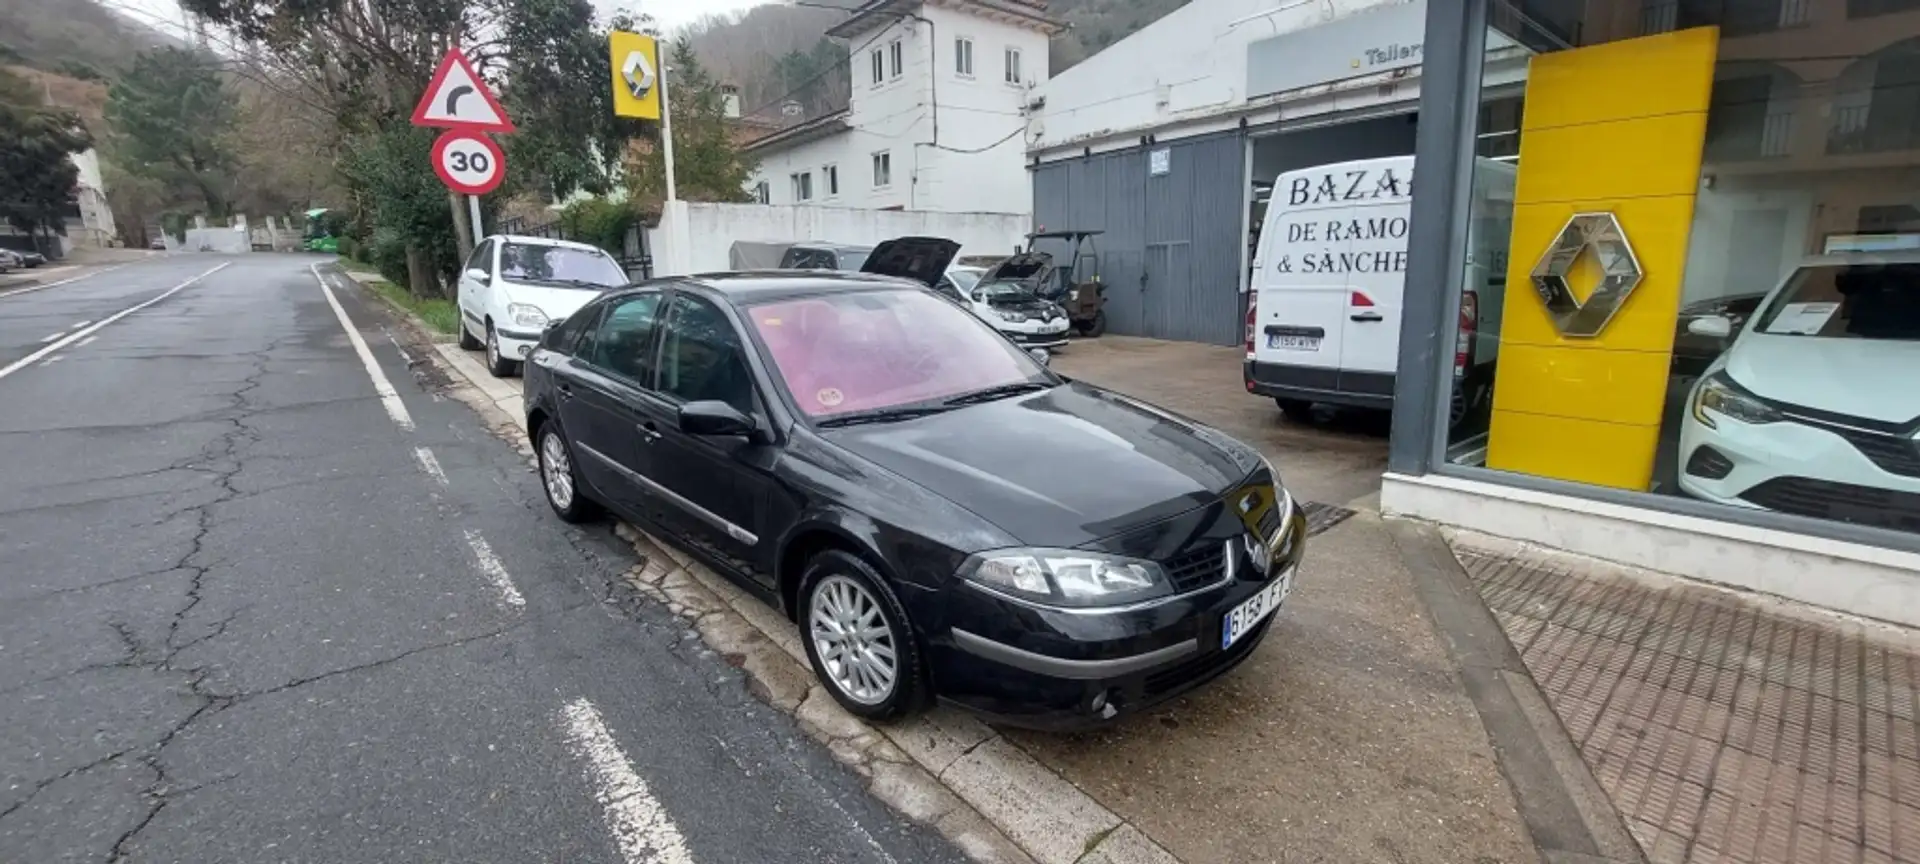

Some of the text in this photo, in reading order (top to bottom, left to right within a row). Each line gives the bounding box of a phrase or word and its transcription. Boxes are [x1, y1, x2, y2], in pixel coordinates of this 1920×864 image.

[1365, 44, 1423, 65] Taller
[450, 151, 489, 174] 30
[1288, 222, 1318, 243] DE
[1277, 254, 1293, 274] &
